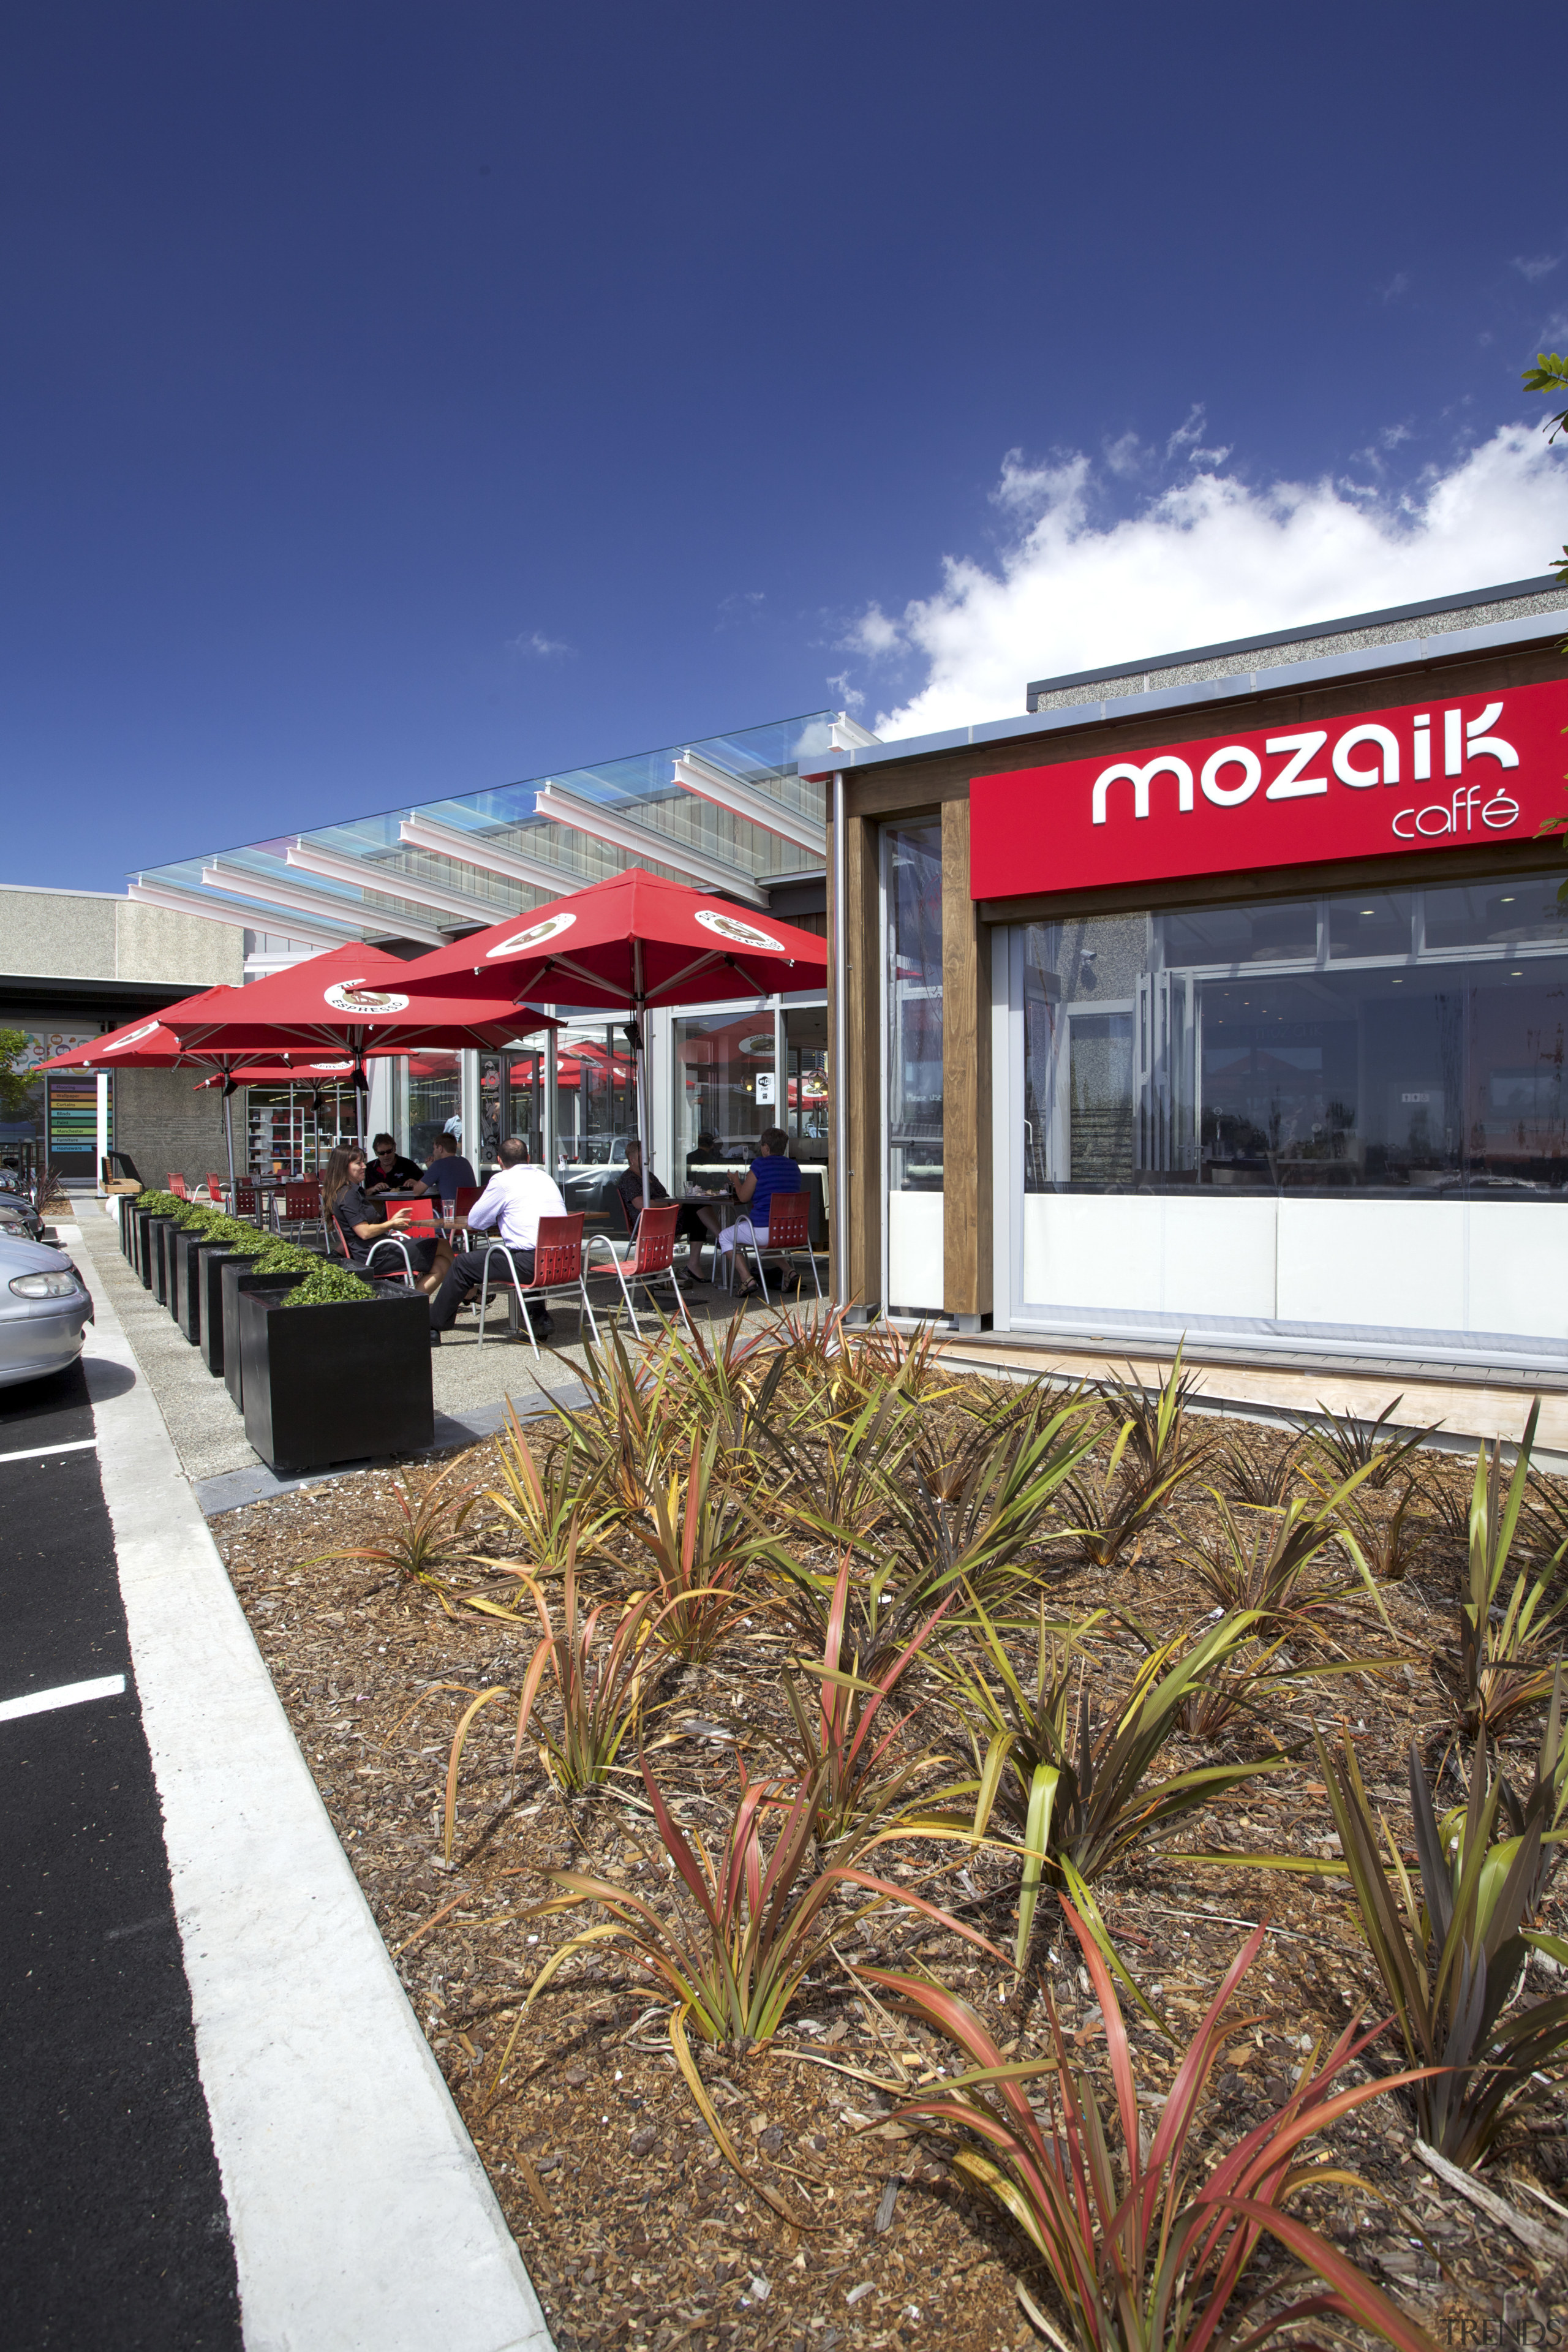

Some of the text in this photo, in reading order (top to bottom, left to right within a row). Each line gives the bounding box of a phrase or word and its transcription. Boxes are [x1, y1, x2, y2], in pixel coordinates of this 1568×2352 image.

[1093, 702, 1519, 824] mozaik
[1392, 785, 1519, 837] caffé
[332, 1000, 402, 1012] ESPRESSO
